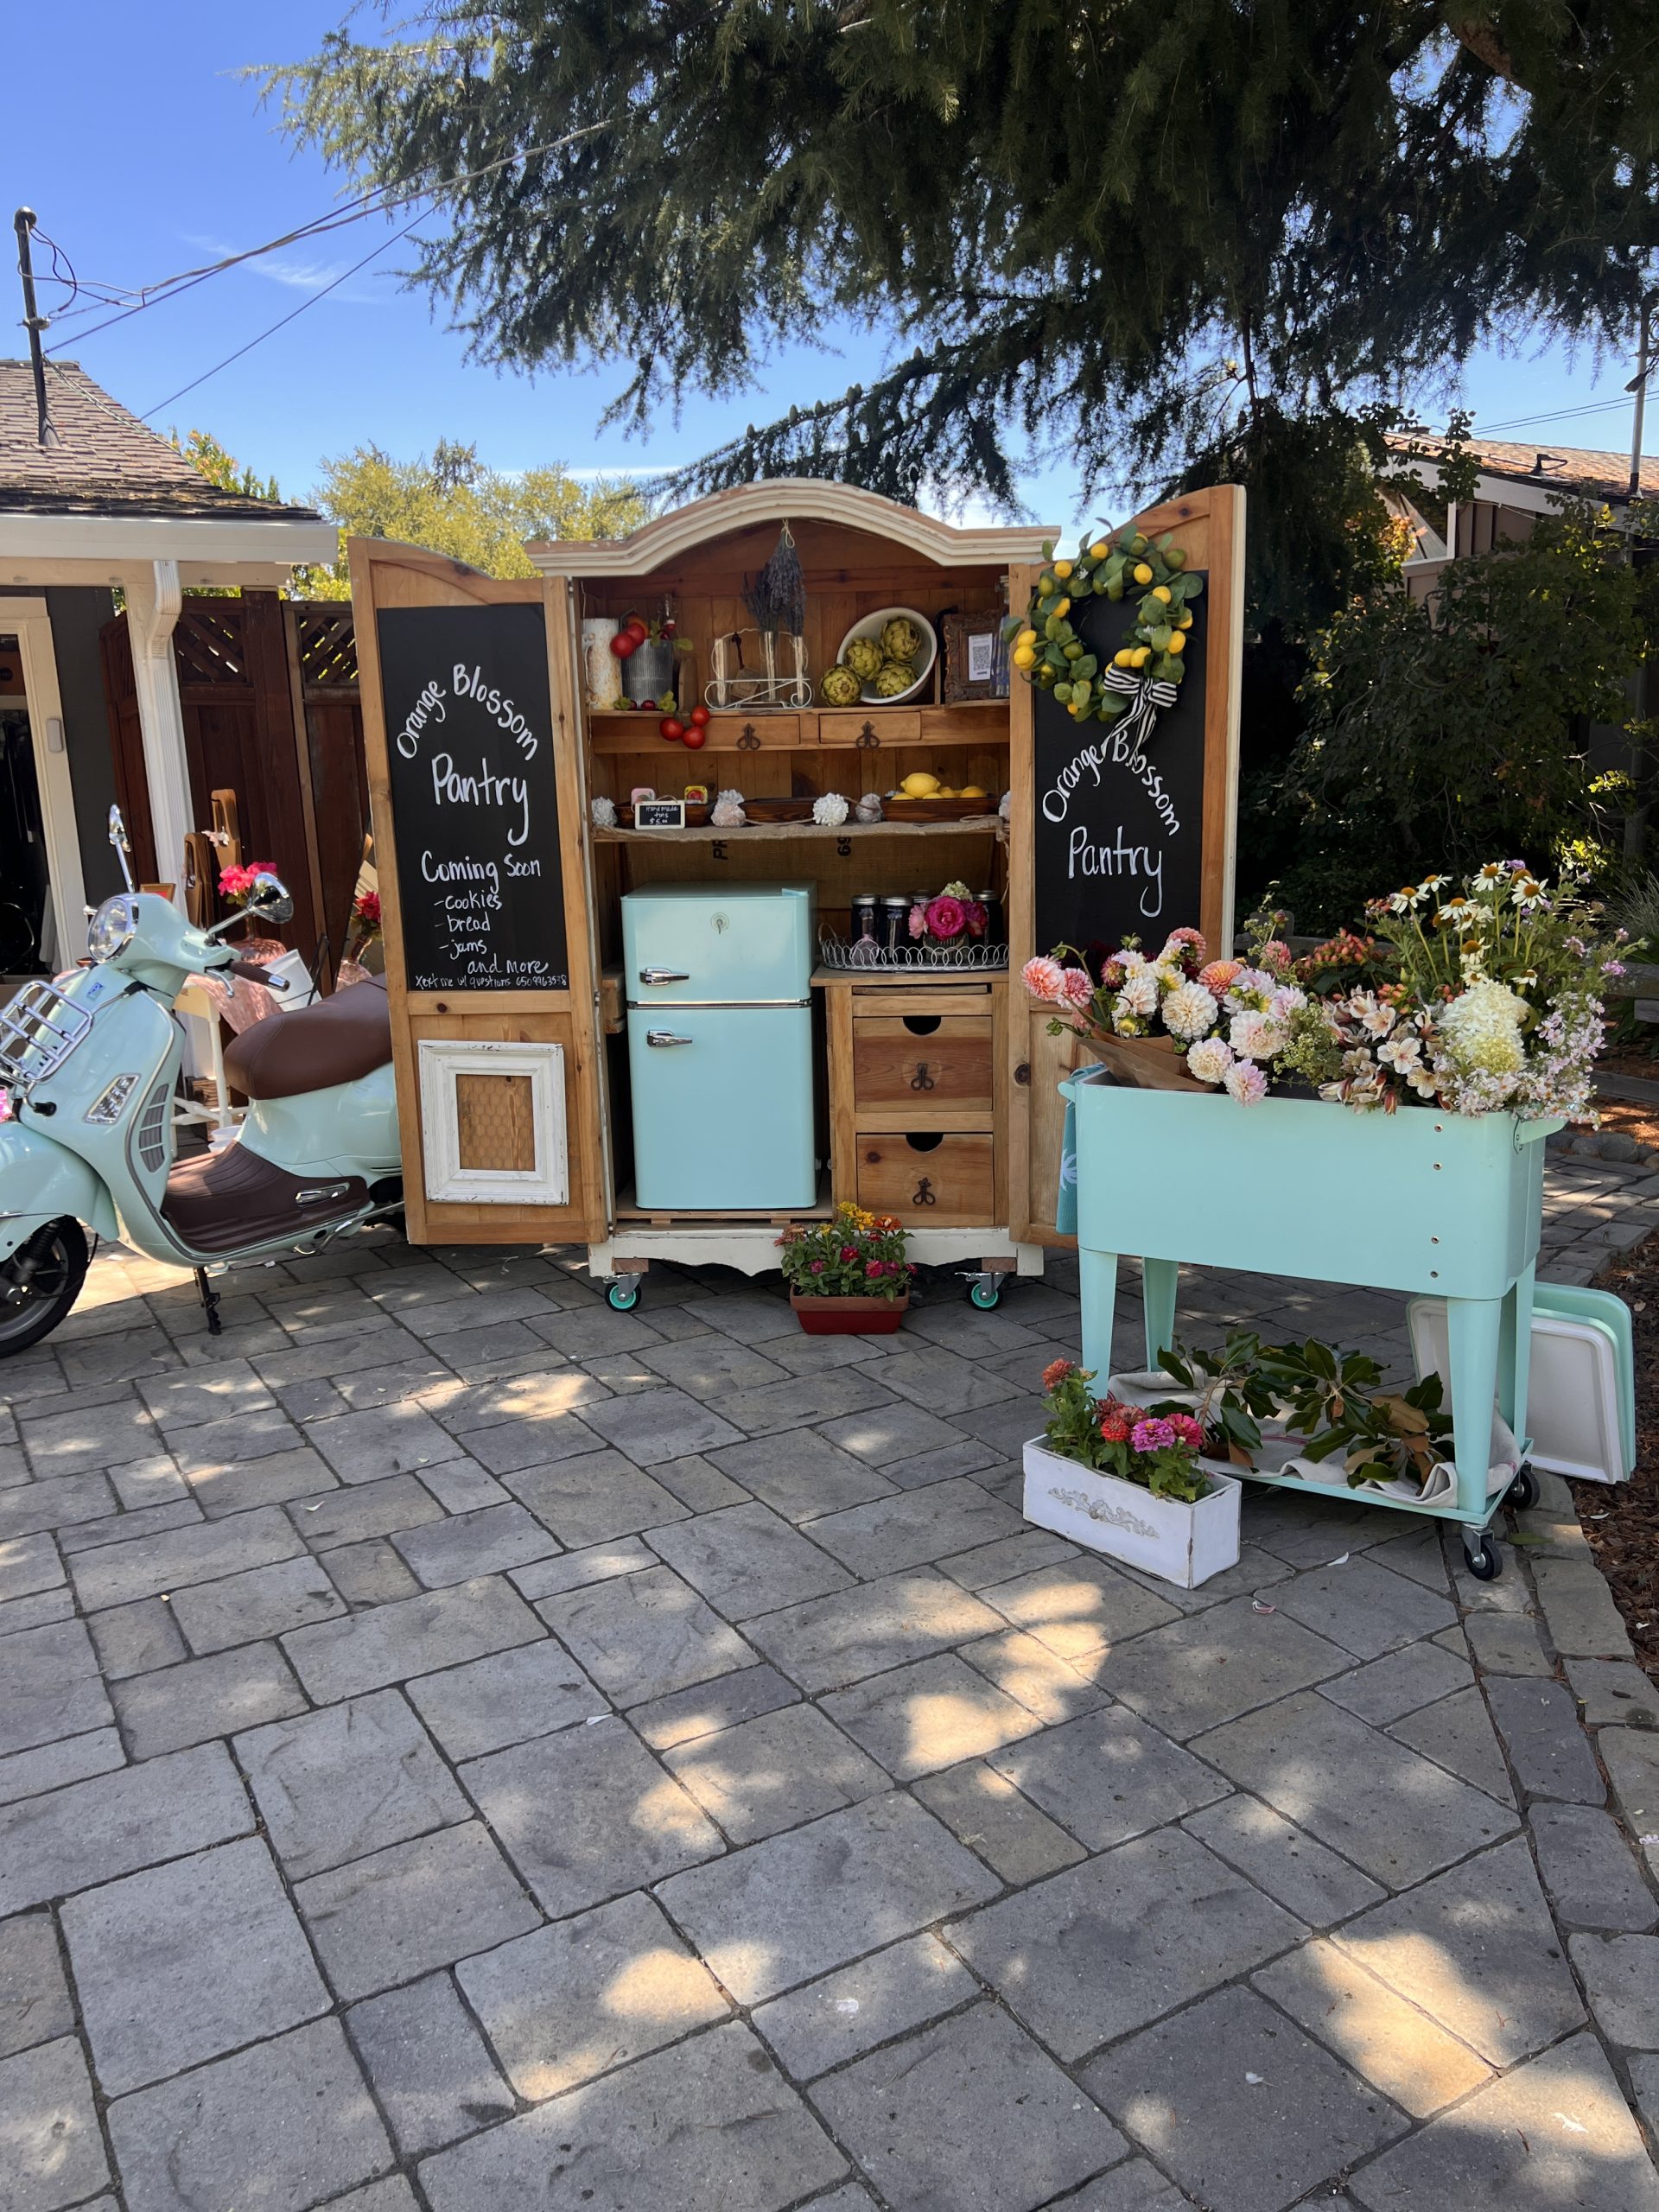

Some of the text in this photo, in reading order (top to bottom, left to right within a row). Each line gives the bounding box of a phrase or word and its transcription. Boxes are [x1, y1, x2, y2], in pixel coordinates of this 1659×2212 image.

[397, 663, 538, 761] Orange Blossom
[431, 753, 529, 846] Pantry
[1042, 729, 1180, 836] Orange Bossom
[421, 850, 541, 895] Coming Soon
[1068, 825, 1163, 918] Pantry
[467, 952, 503, 975] and
